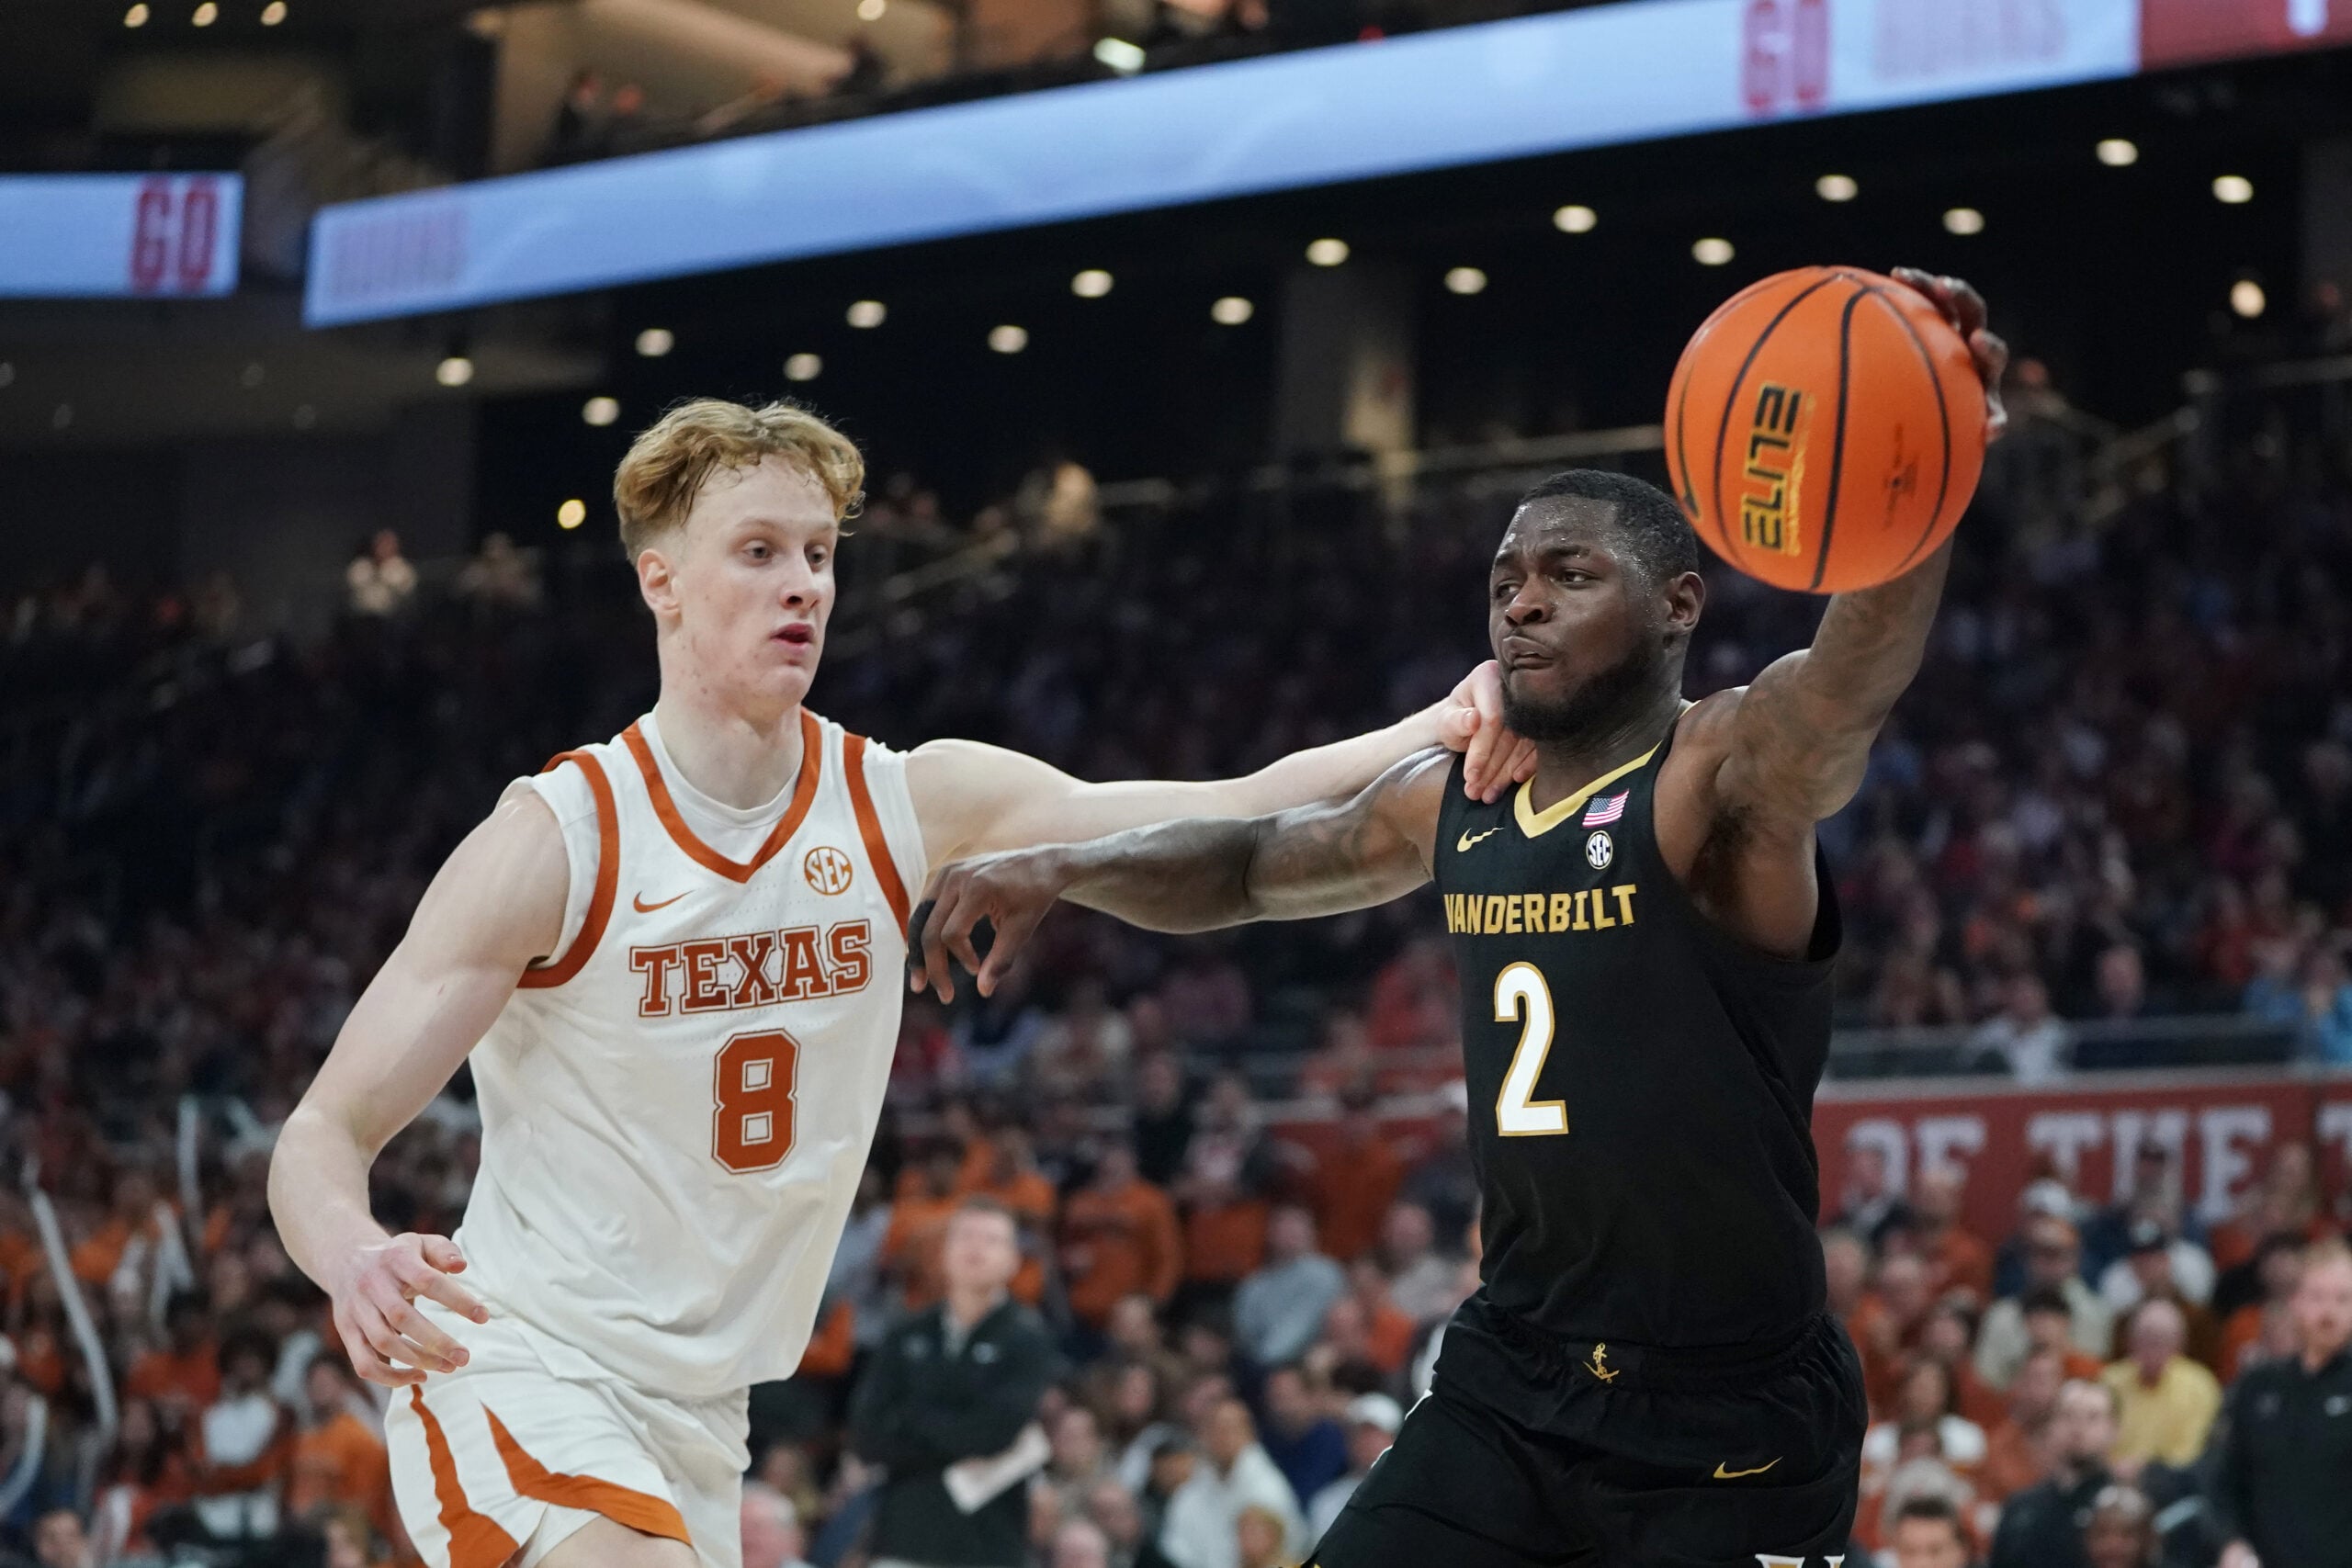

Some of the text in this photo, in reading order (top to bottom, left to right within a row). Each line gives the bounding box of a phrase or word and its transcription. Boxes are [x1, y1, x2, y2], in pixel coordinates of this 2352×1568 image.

[131, 178, 219, 291] GO
[1743, 383, 1802, 550] ELITE
[805, 847, 853, 896] SEC
[1588, 831, 1612, 868] SEC
[1444, 885, 1637, 934] VANDERBILT
[630, 919, 872, 1017] TEXAS
[711, 1028, 800, 1175] 8
[1494, 962, 1568, 1136] 2
[2026, 1107, 2271, 1224] THE
